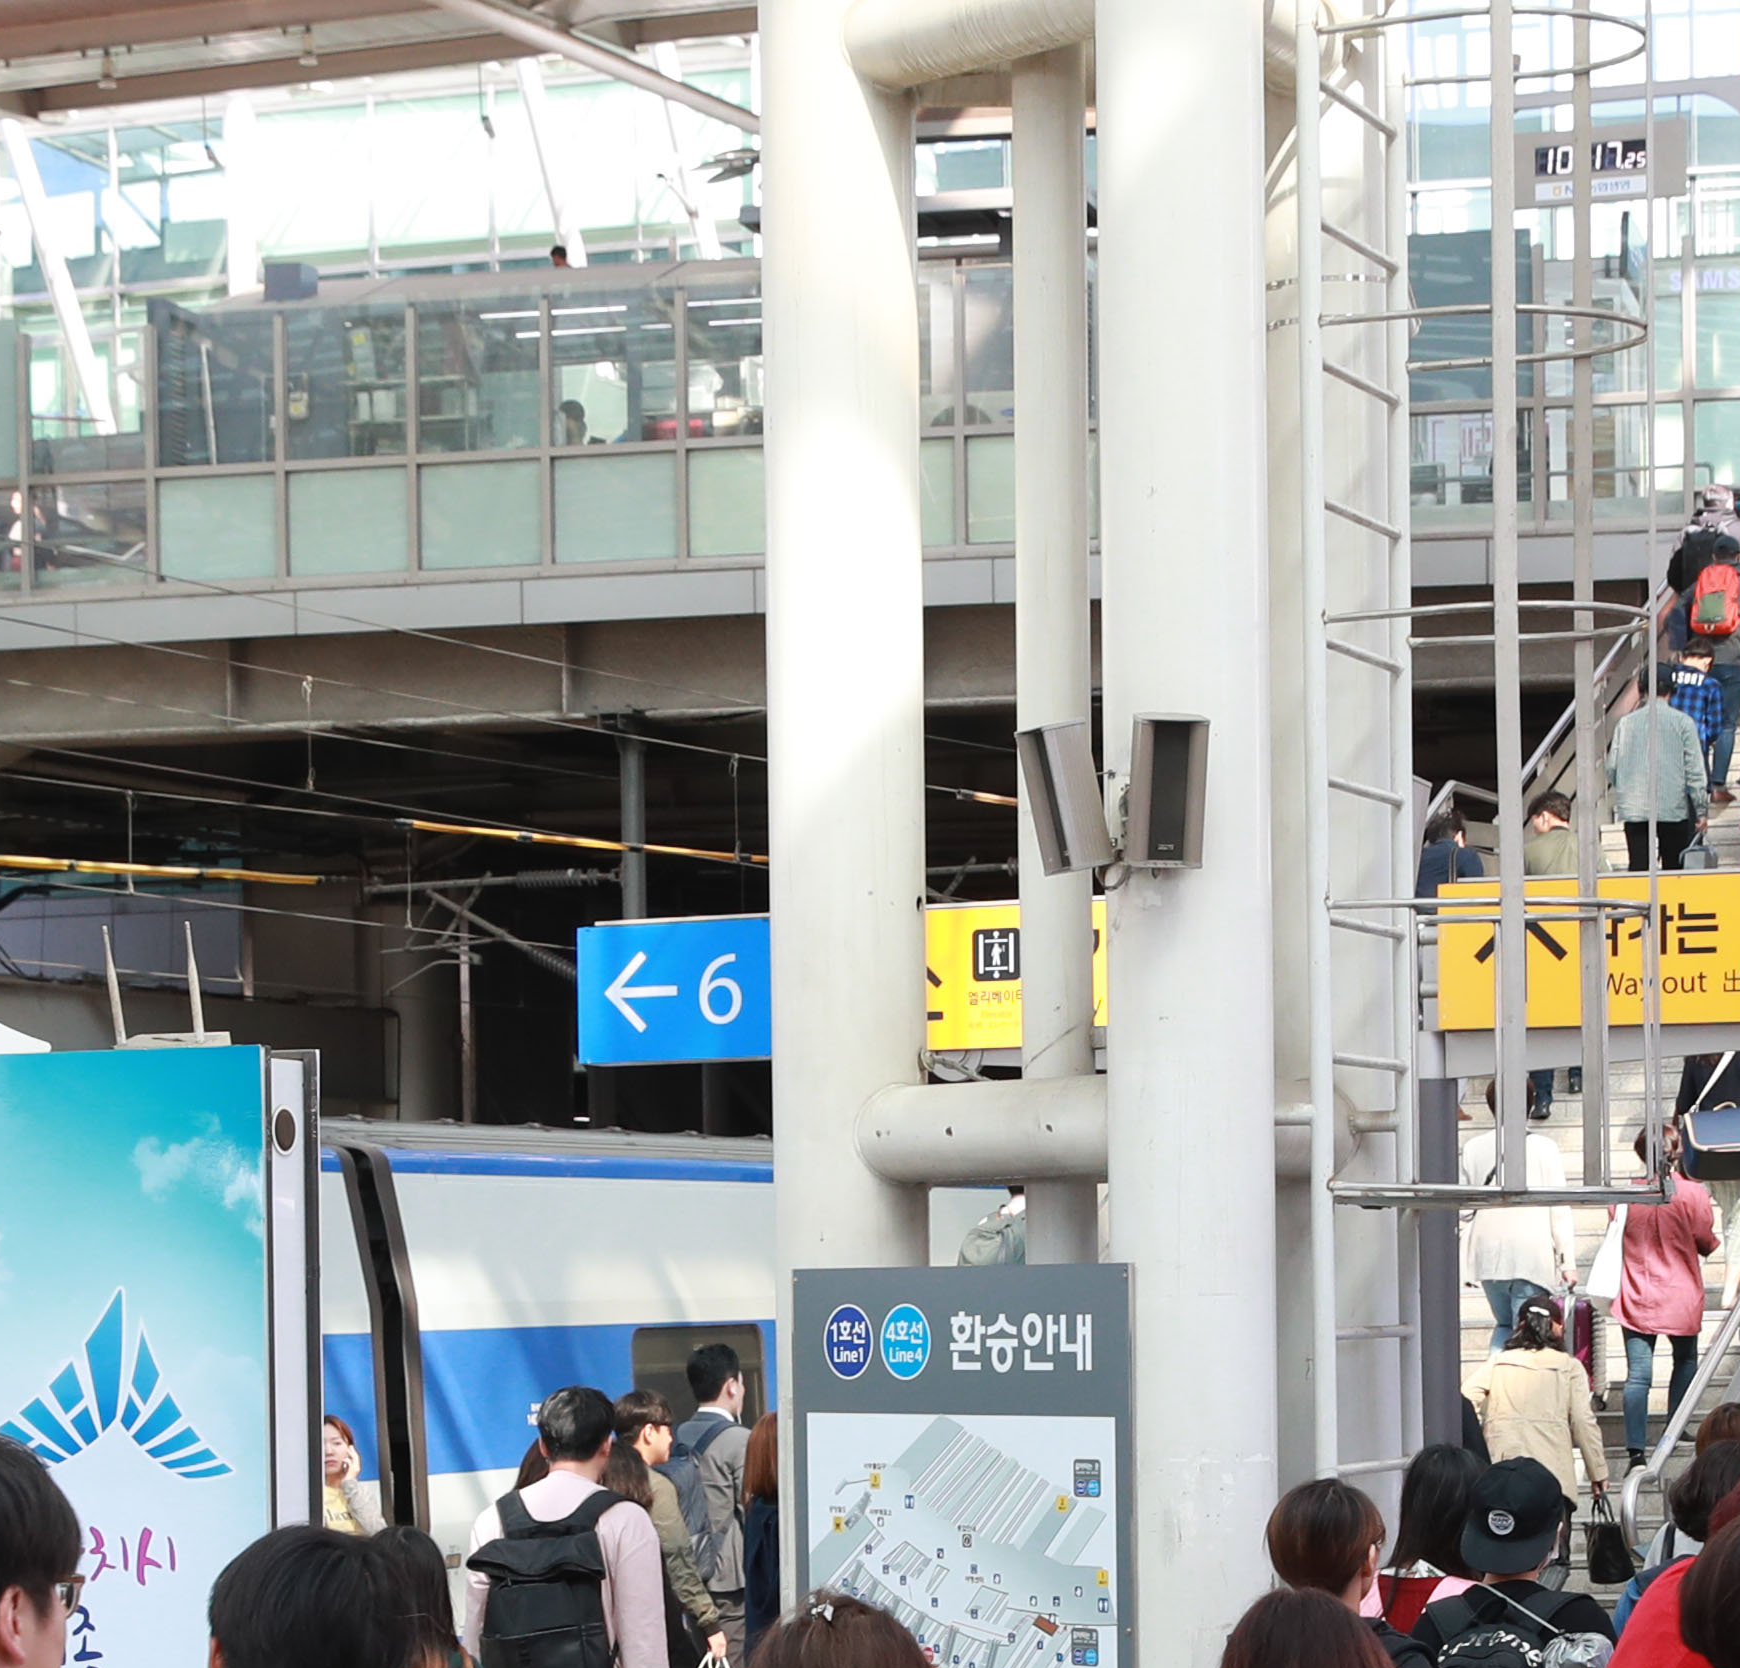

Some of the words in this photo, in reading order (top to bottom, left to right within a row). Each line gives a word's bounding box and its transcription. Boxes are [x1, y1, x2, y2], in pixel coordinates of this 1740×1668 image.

[698, 952, 743, 1026] 6
[1662, 971, 1707, 994] out
[829, 1320, 866, 1344] 1호선
[885, 1320, 923, 1344] 4호선
[950, 1311, 1092, 1372] 환승안내
[833, 1346, 864, 1363] Line1
[889, 1346, 923, 1363] Line4
